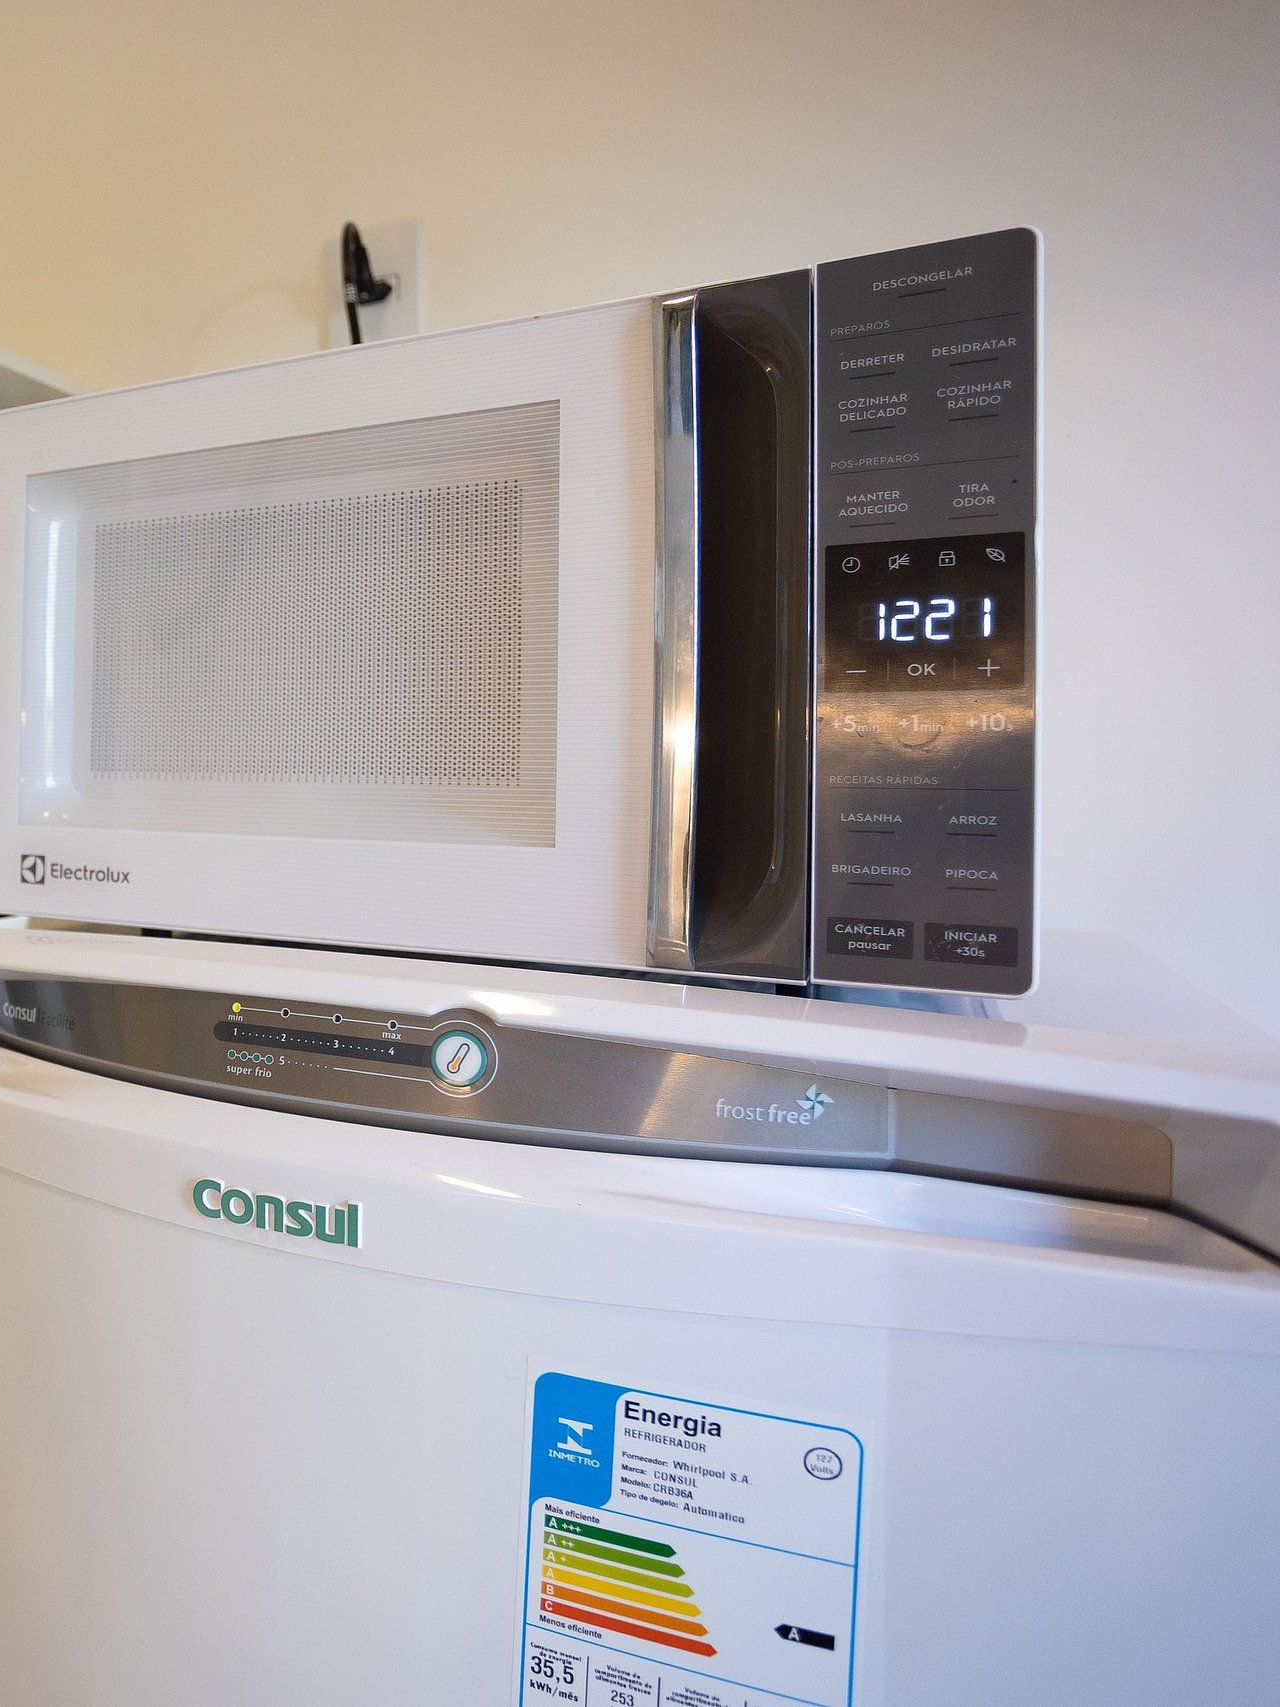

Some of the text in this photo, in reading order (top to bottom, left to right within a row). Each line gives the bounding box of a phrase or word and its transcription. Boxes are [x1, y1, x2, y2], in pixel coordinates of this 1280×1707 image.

[872, 267, 973, 292] DESCONGELAR
[830, 320, 890, 337] PREPAROS
[931, 337, 1017, 357] DESIDRATAR
[840, 353, 904, 370] DERRETER
[936, 380, 1012, 398] COZINHAR
[837, 394, 908, 410] COZINHAR
[947, 393, 1001, 410] RÁPIDO
[839, 406, 907, 423] DELICADO
[958, 483, 990, 494] TIRA
[846, 490, 900, 504] MANTER
[952, 495, 995, 508] ODOR
[838, 502, 909, 518] AQUECIDO
[877, 597, 992, 642] 1221
[907, 663, 936, 677] OK
[829, 774, 938, 786] RECEITAS RÁPIDAS
[840, 813, 903, 824] LASANHA
[949, 815, 998, 826] ARROZ
[50, 862, 130, 884] Electrolux
[831, 864, 912, 877] BRIGADEIRO
[945, 868, 999, 881] PIPOCA
[835, 923, 906, 938] CANCELAR
[944, 930, 998, 944] INICIAR
[848, 940, 892, 951] pausar
[955, 946, 986, 958] +30s
[228, 1013, 243, 1022] min
[233, 1027, 395, 1056] 1 2 3 4
[382, 1031, 402, 1041] max
[278, 1056, 286, 1066] 5
[226, 1064, 273, 1079] super frio
[715, 1098, 812, 1126] frost free
[192, 1176, 363, 1250] Consul
[624, 1400, 722, 1438] Energia
[624, 1427, 707, 1453] REFRIGERADOR
[548, 1448, 600, 1468] INMETRO
[621, 1450, 669, 1468] Fornecedor:
[672, 1460, 725, 1480] Whirlpool
[621, 1463, 698, 1488] Marca: CONSUL
[620, 1476, 694, 1501] Modelo: CRB36A
[620, 1488, 637, 1499] Tipo
[638, 1493, 649, 1501] de
[544, 1503, 600, 1525] Mais eficiente
[545, 1567, 555, 1579] A
[546, 1585, 555, 1596] B
[544, 1601, 553, 1612] C
[539, 1614, 602, 1640] Menos eficiente
[788, 1627, 800, 1642] A
[530, 1655, 575, 1685] 35,5
[529, 1678, 579, 1703] kWh/mês
[611, 1689, 634, 1707] 253
